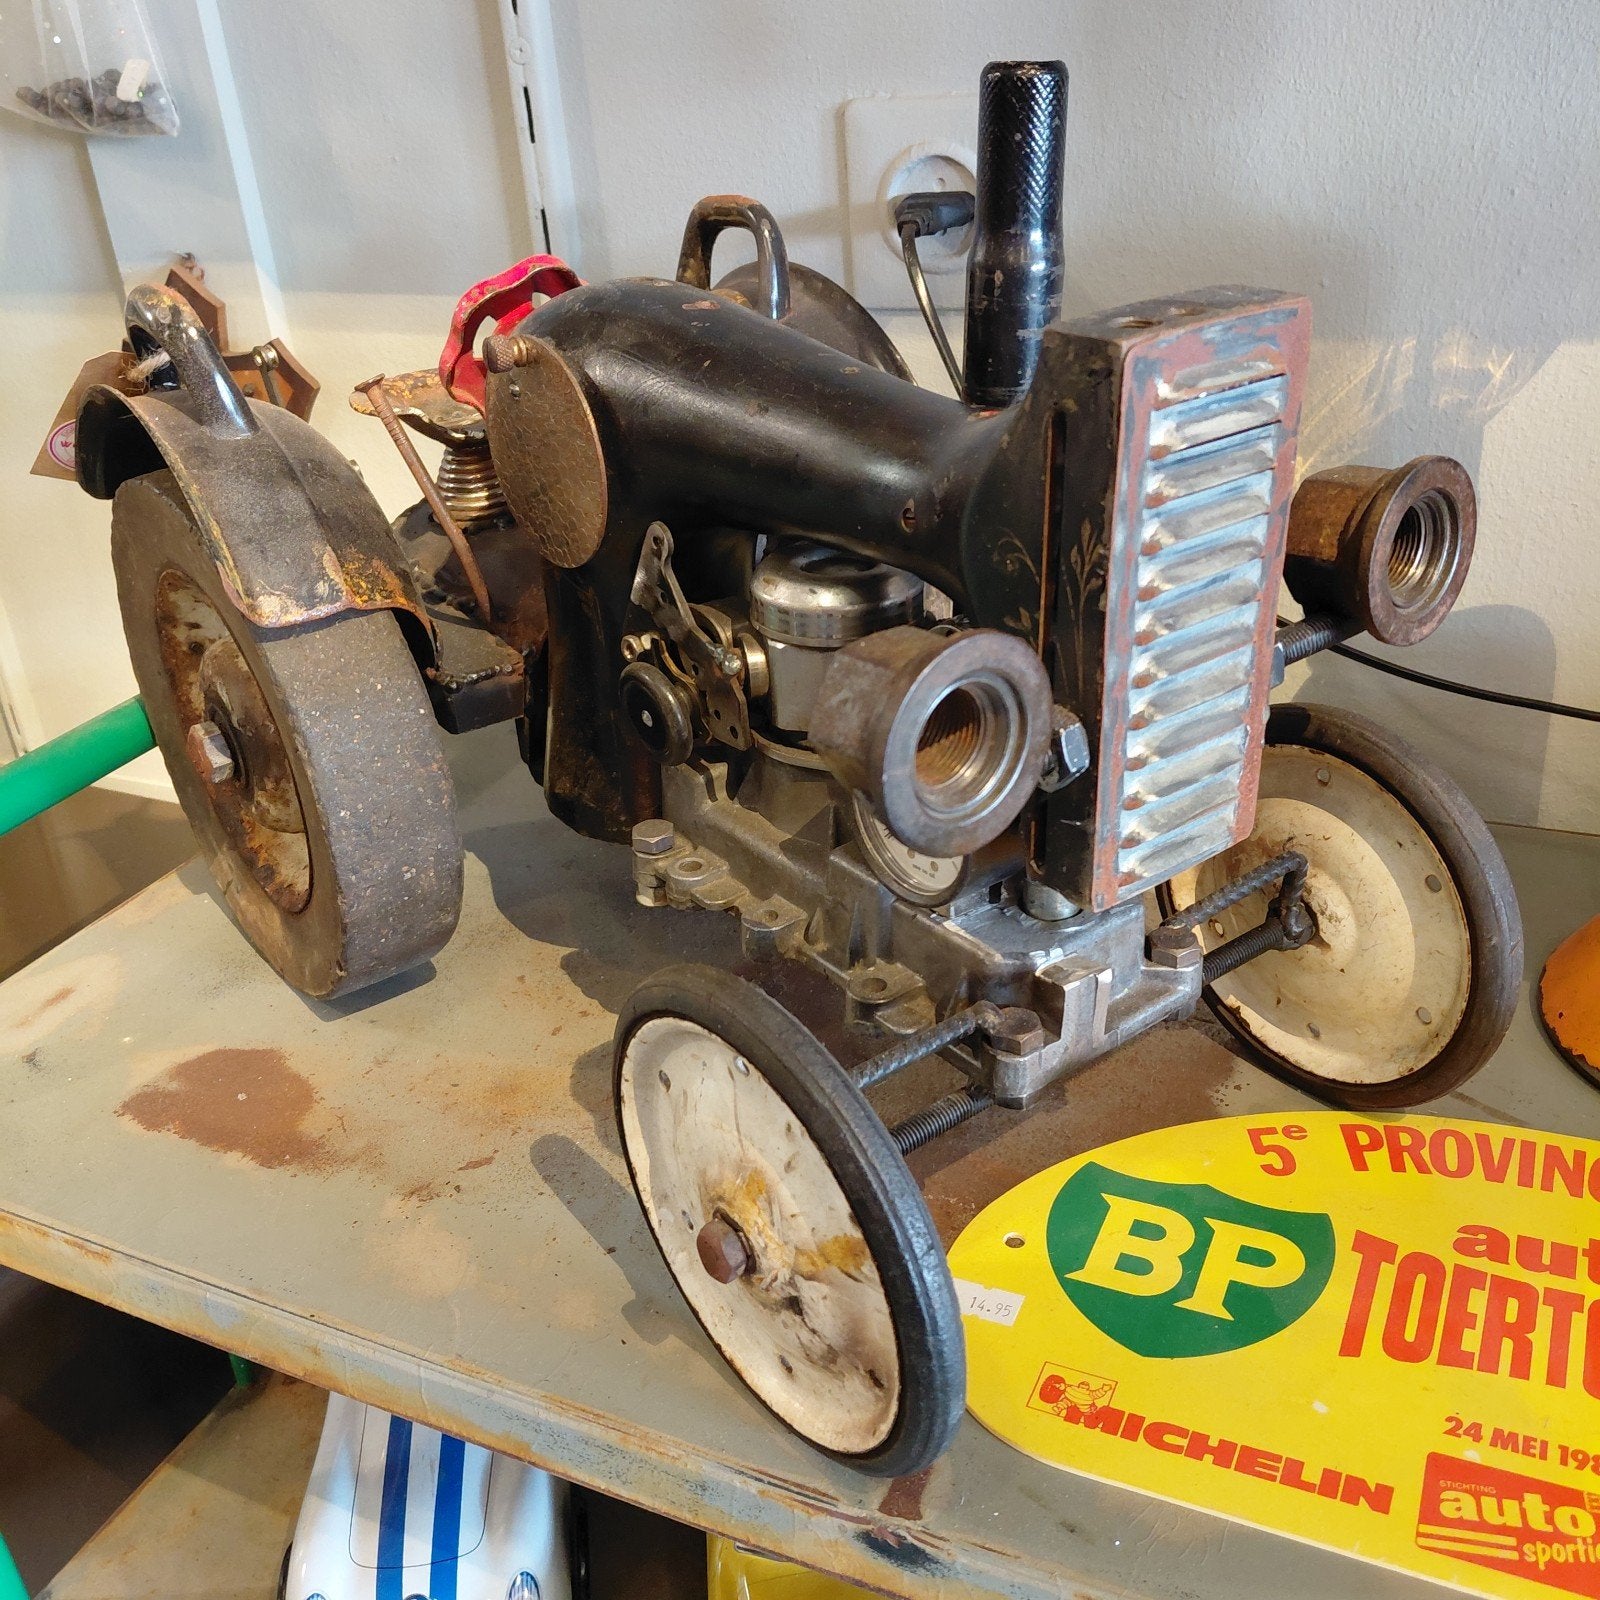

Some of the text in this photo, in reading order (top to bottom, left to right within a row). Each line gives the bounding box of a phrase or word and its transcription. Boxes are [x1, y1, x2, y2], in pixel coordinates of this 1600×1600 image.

[1339, 1124, 1600, 1203] PROVIN
[1064, 1193, 1306, 1321] BP
[969, 1296, 1013, 1317] 14.95
[1063, 1405, 1394, 1515] MICHELIN
[1442, 1415, 1483, 1443] 24
[1489, 1427, 1548, 1461] MEI
[1439, 1479, 1497, 1494] STICHTING
[1439, 1490, 1596, 1538] auto
[1522, 1536, 1600, 1571] sporti
